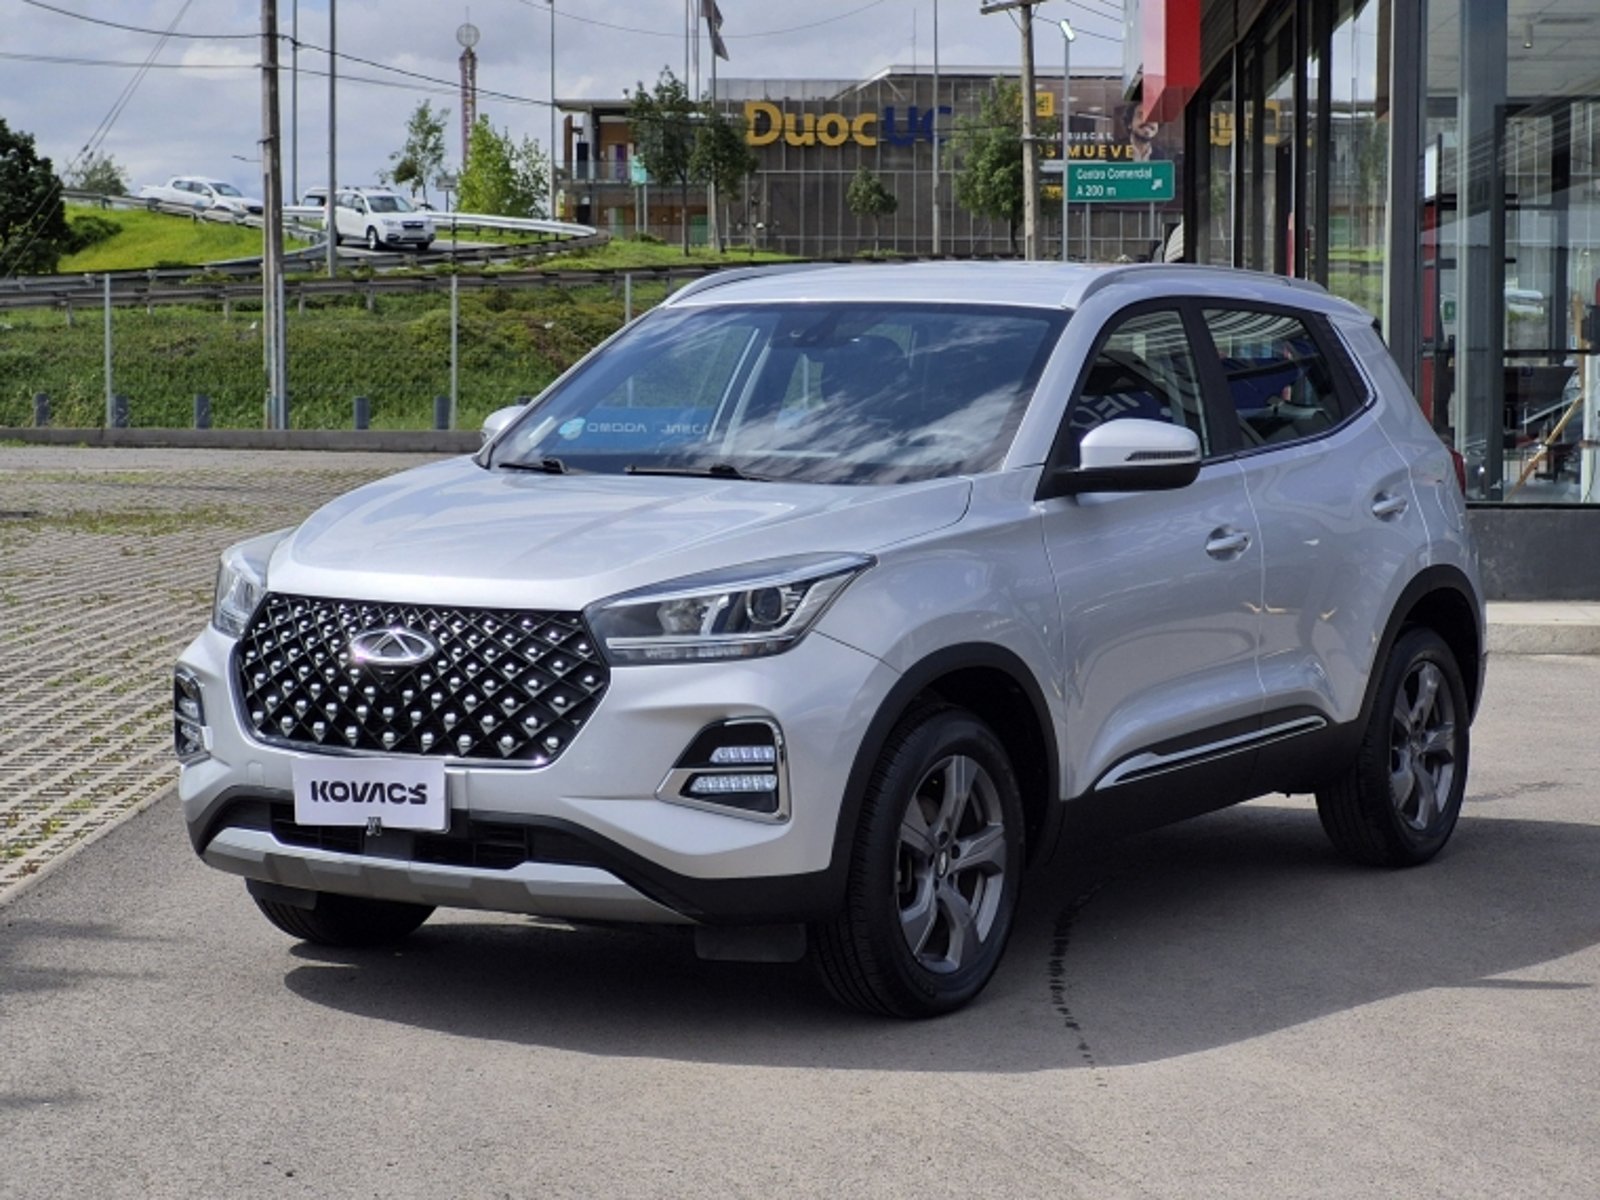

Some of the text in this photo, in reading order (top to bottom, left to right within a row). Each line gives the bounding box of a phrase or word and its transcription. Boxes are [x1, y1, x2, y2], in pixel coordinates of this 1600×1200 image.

[745, 102, 952, 148] Duoc UC
[1068, 145, 1133, 157] MUEVE
[1107, 167, 1152, 179] Comercial
[1076, 185, 1116, 196] A 200 m
[586, 422, 648, 433] OMODA
[310, 780, 428, 805] KOVACS
